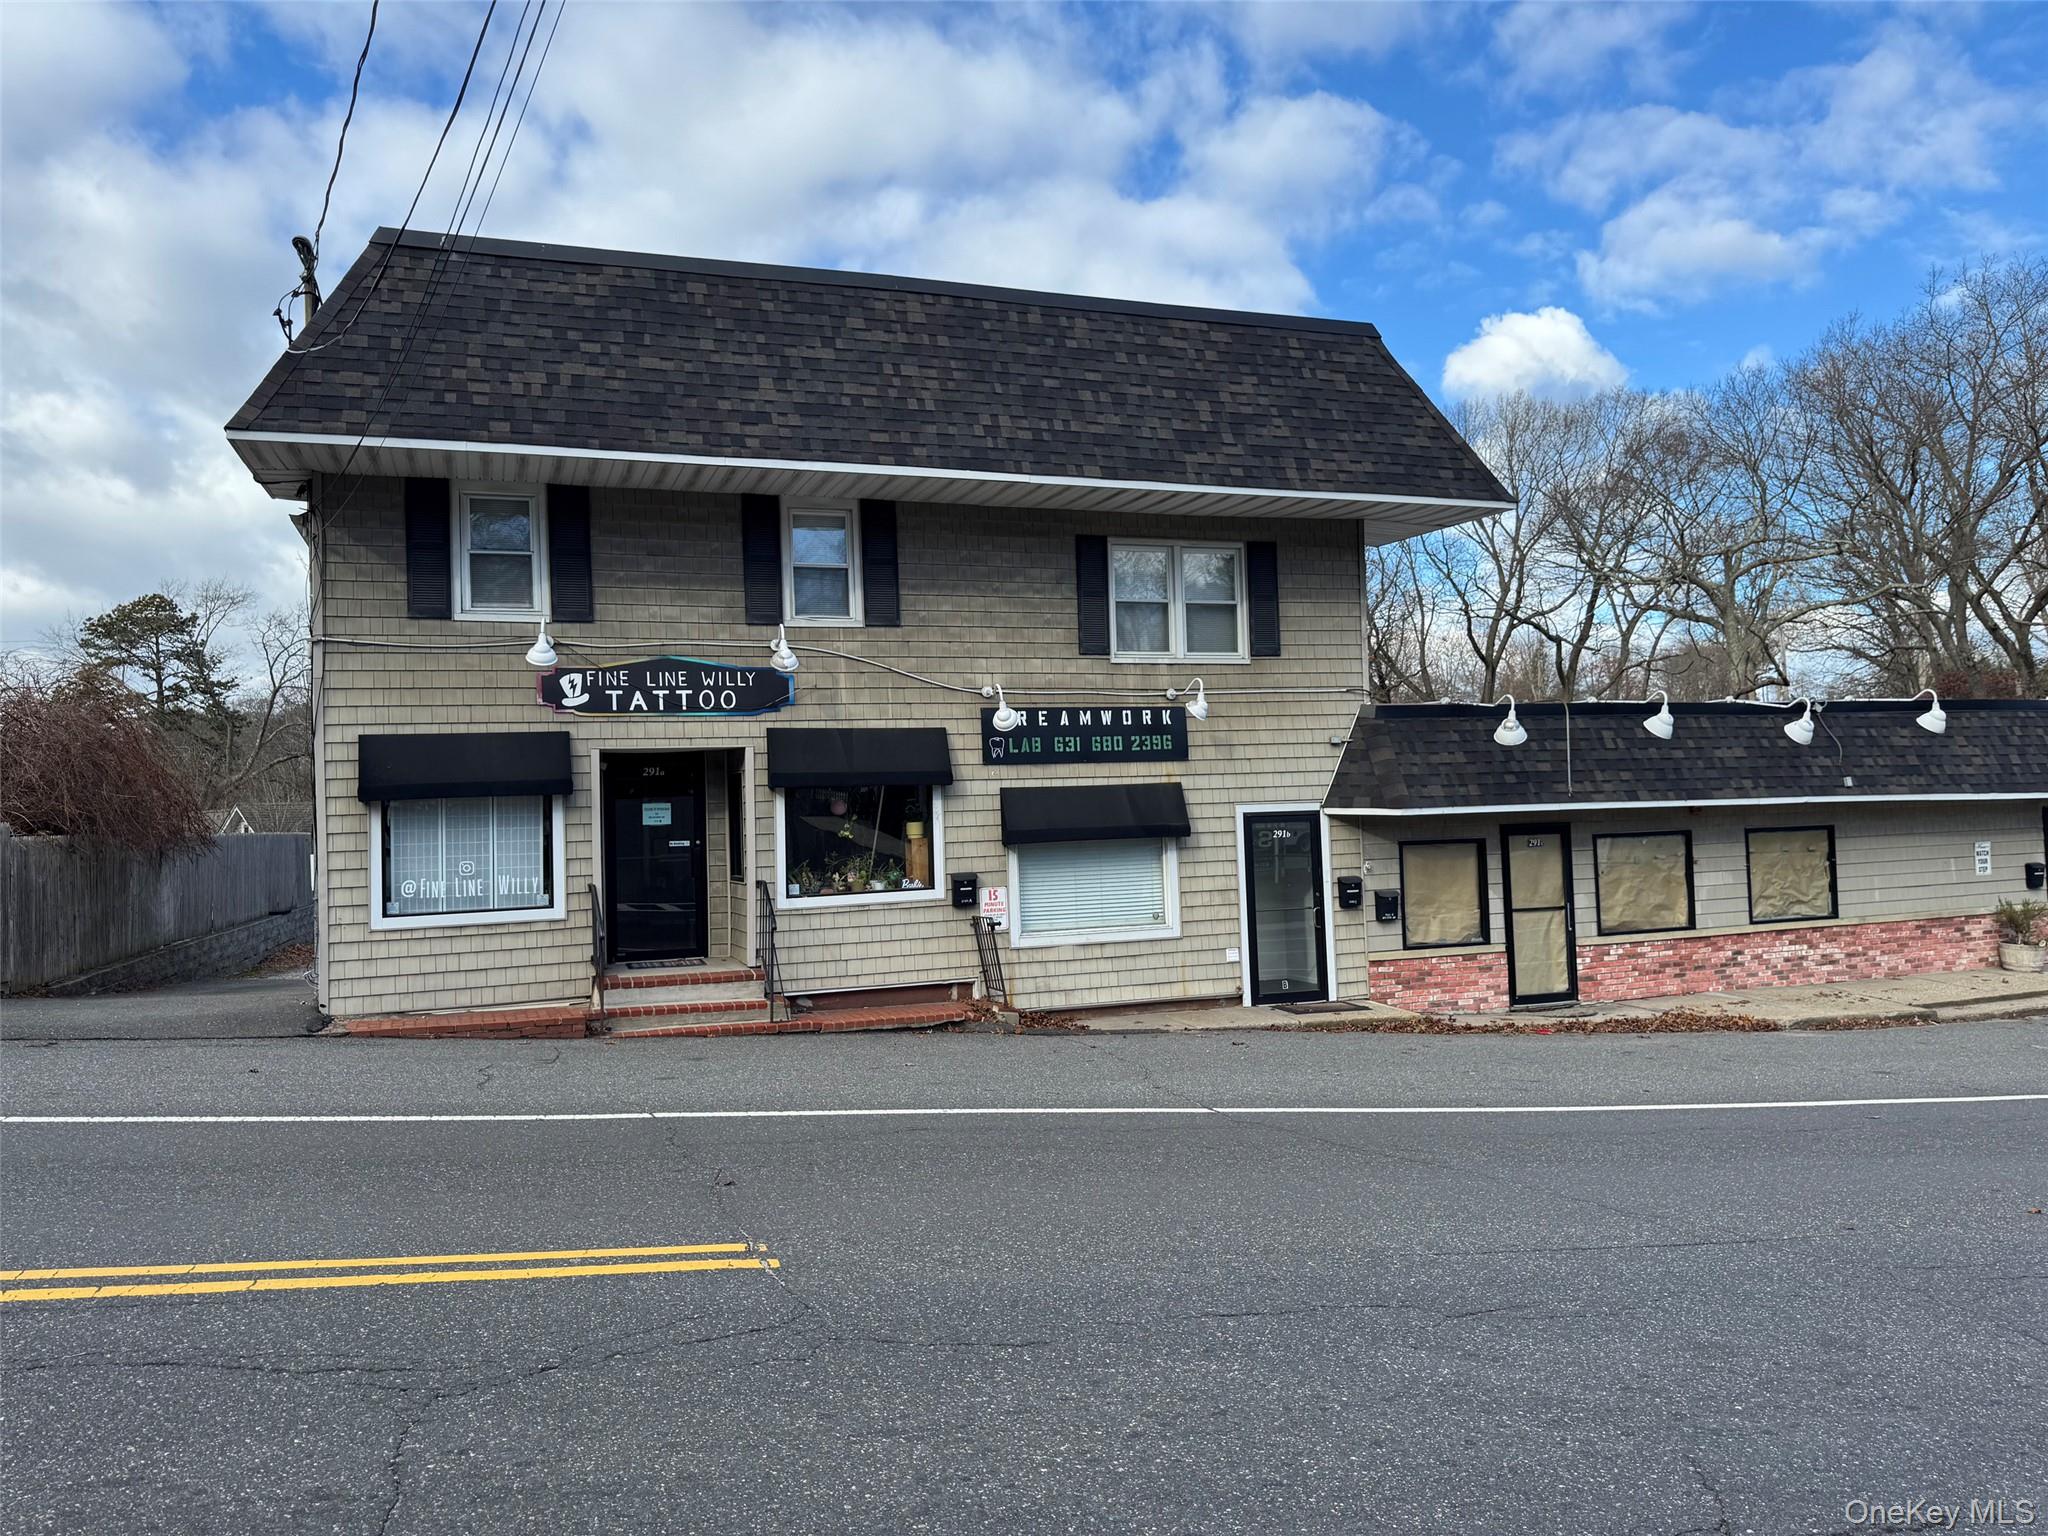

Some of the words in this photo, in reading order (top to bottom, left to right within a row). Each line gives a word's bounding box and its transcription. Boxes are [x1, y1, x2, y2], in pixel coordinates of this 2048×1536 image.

[586, 670, 629, 686] FINE
[646, 671, 688, 687] LINE
[701, 671, 756, 686] WILLY
[605, 690, 737, 711] TATTOO
[1015, 709, 1172, 727] REAMWORK
[1008, 737, 1041, 753] LAB
[1054, 736, 1081, 752] 631
[1092, 735, 1123, 752] 680
[1131, 735, 1172, 751] 2396
[1272, 829, 1291, 838] 291b
[455, 877, 484, 898] LINE
[498, 875, 538, 895] WILLY
[988, 889, 999, 902] 15
